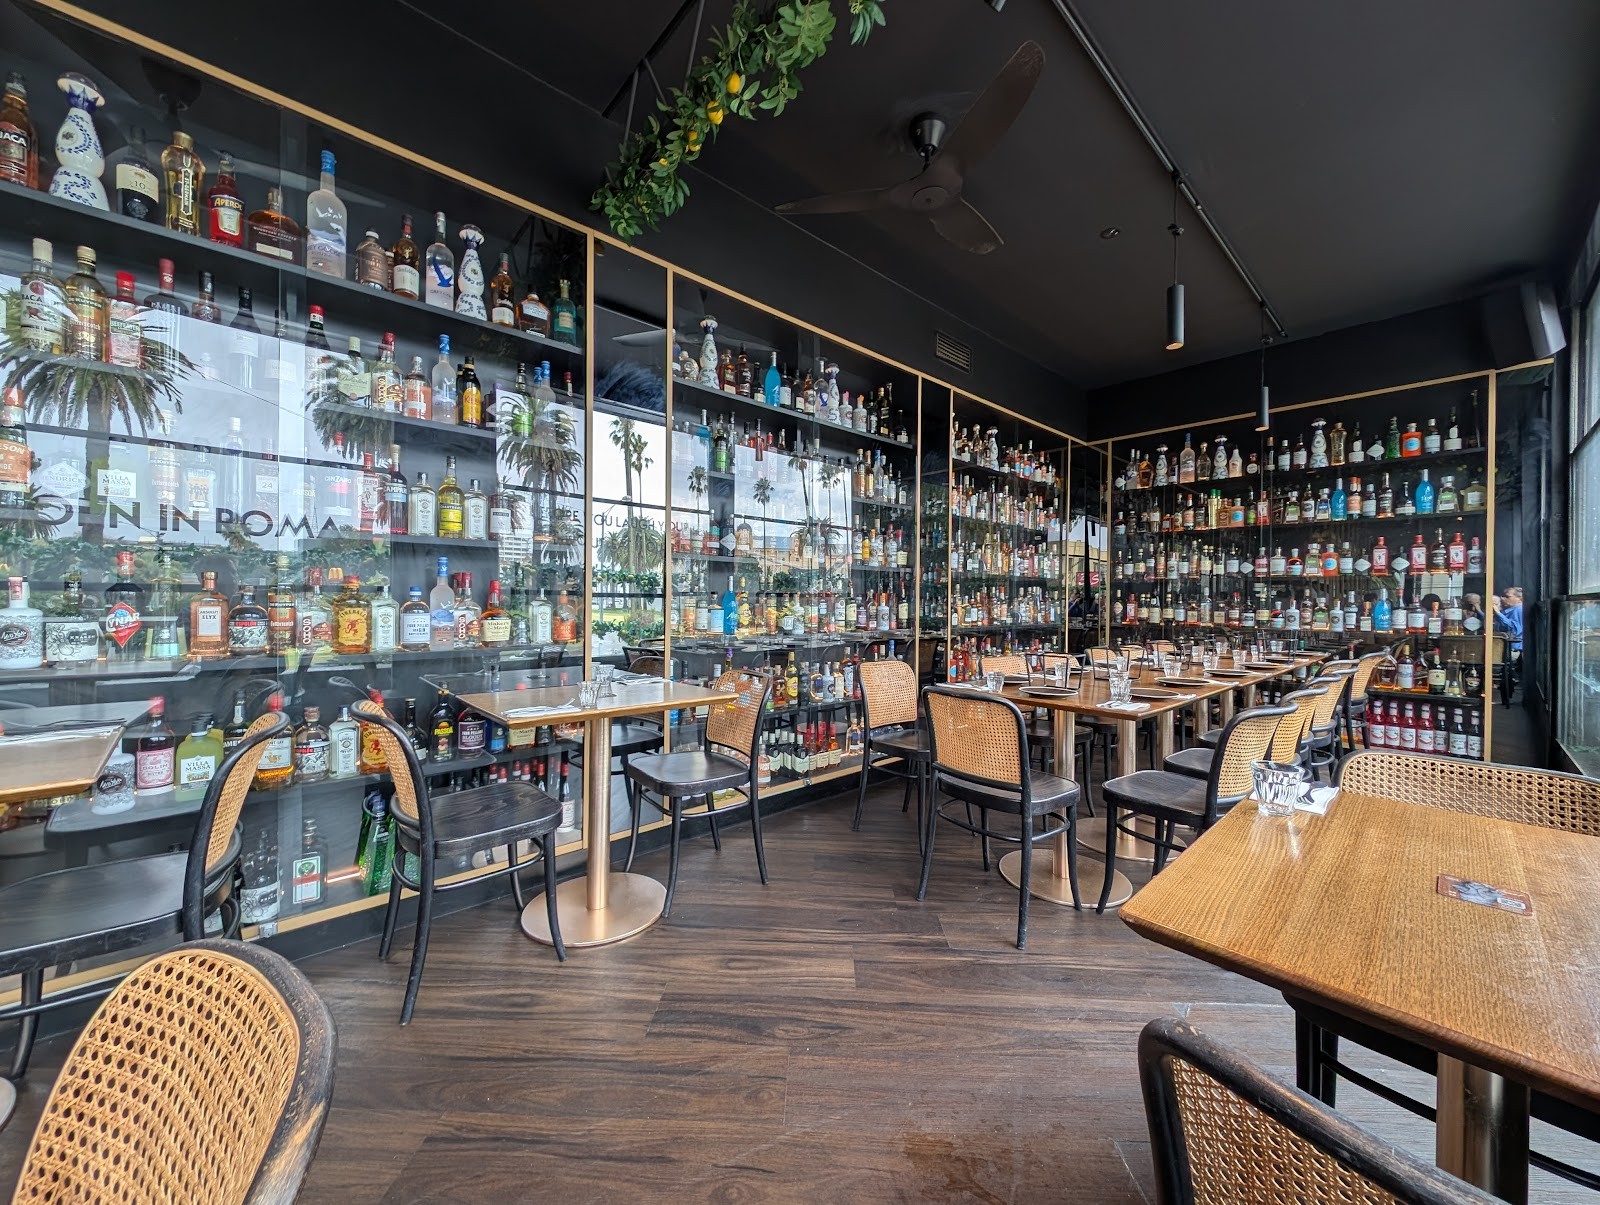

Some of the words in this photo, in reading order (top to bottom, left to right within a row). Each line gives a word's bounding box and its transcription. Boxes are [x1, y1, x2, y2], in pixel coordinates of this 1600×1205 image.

[214, 197, 243, 210] APEROL
[261, 481, 273, 489] 24
[325, 475, 352, 484] CINZANO
[159, 503, 200, 532] IN
[592, 513, 613, 527] OU
[616, 515, 655, 531] LAUGH
[340, 609, 367, 619] FIREBALL
[106, 613, 140, 633] CYNAR
[302, 619, 312, 645] SOHO
[142, 763, 168, 771] DOLIN
